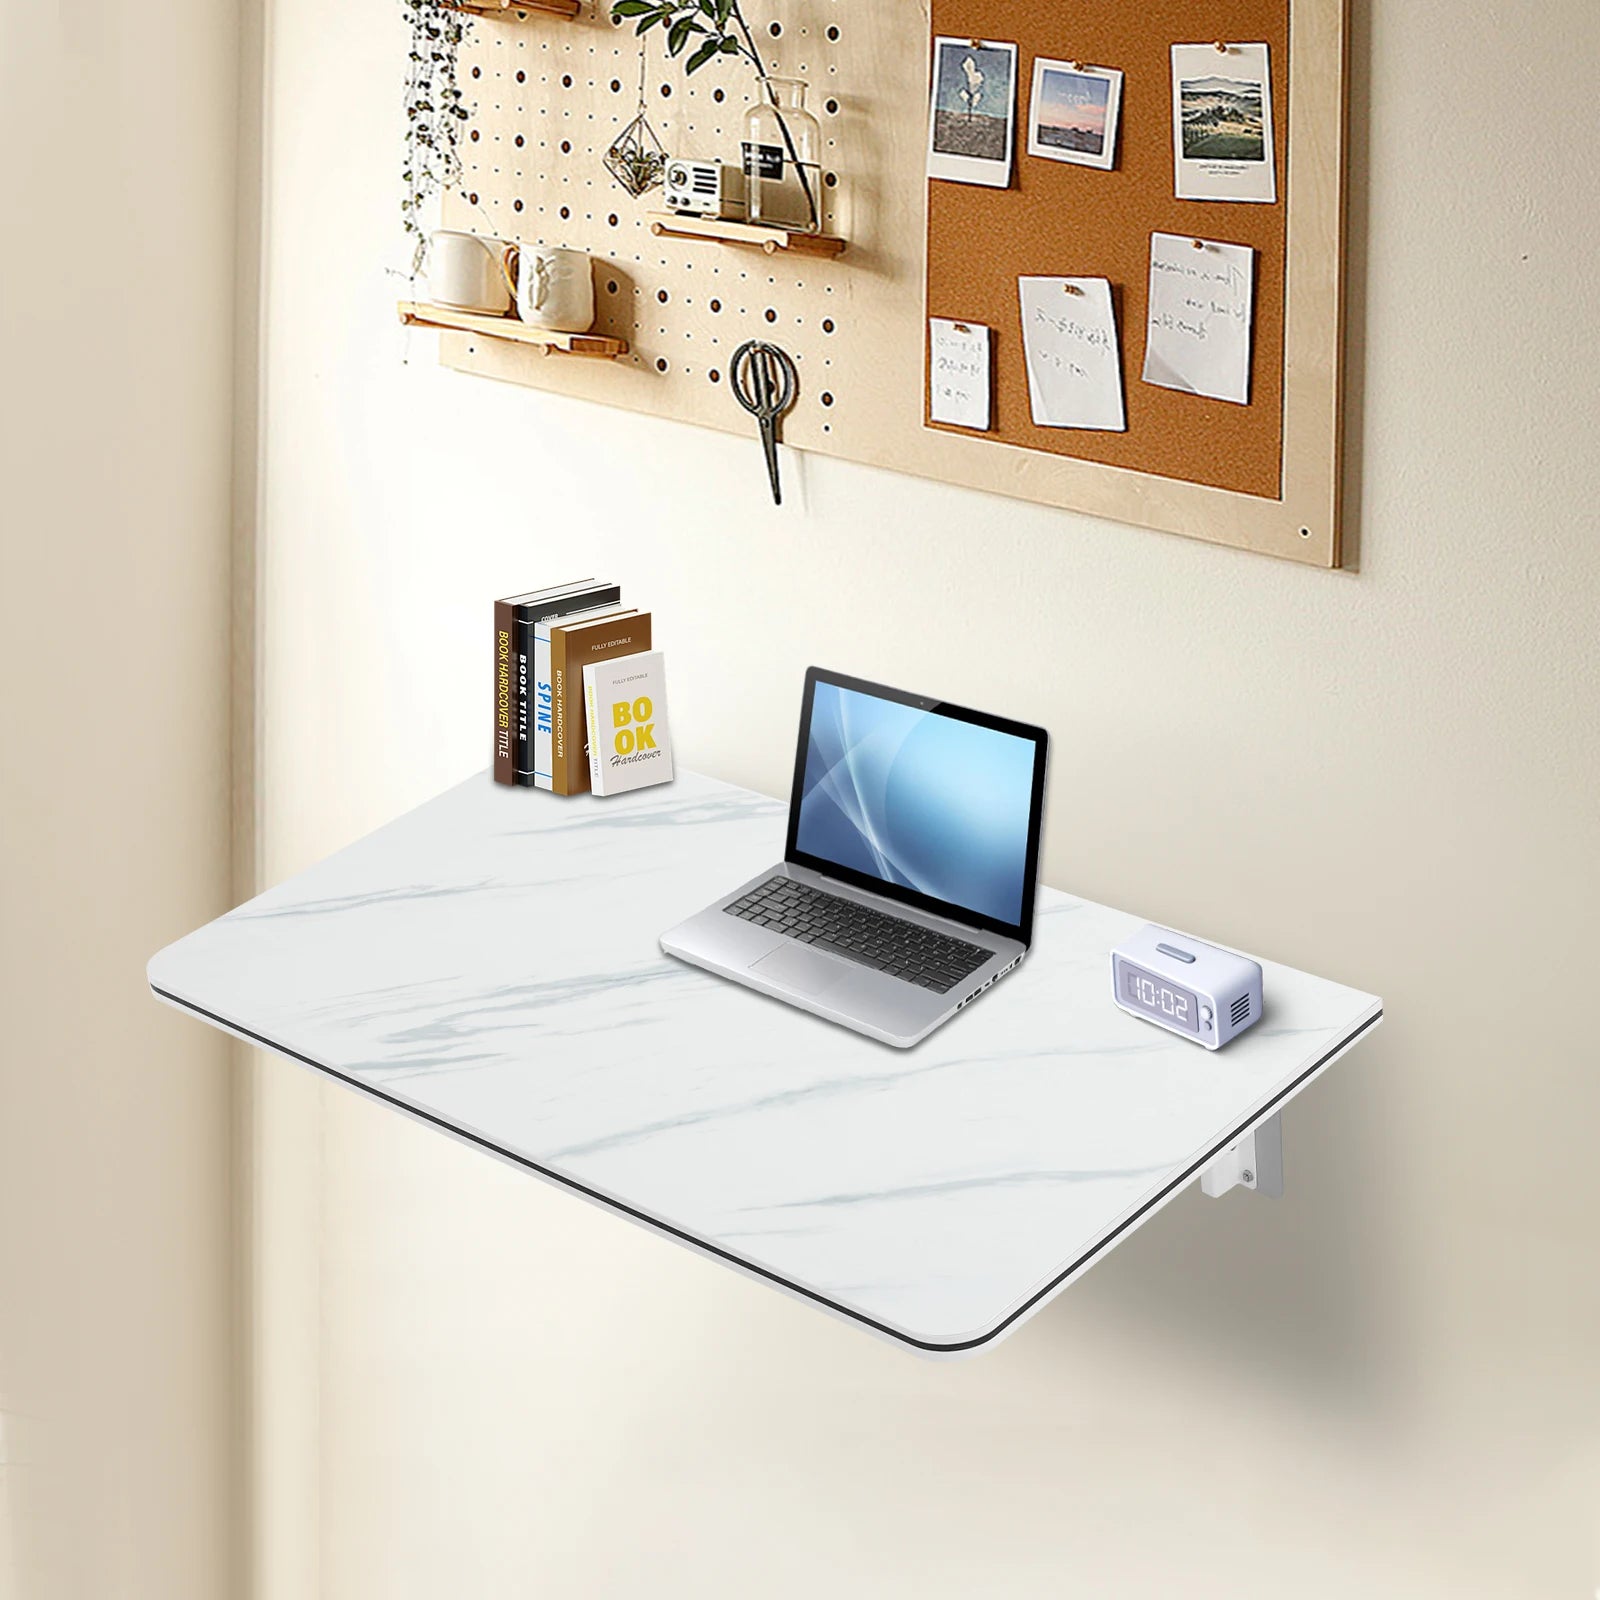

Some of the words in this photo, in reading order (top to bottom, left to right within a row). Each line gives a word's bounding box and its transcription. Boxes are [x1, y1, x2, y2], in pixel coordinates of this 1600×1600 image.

[498, 630, 509, 662] BOOK
[591, 642, 607, 651] FULLY
[608, 637, 632, 648] EDITABLE
[519, 654, 527, 696] BOOK
[498, 663, 509, 729] HARDCOVER
[537, 681, 552, 734] SPINE
[612, 696, 653, 728] BO
[519, 699, 527, 742] TITLE
[498, 729, 509, 759] TITLE
[615, 724, 657, 755] OK
[610, 750, 662, 767] Hardcover
[1136, 976, 1188, 1022] 10:02
